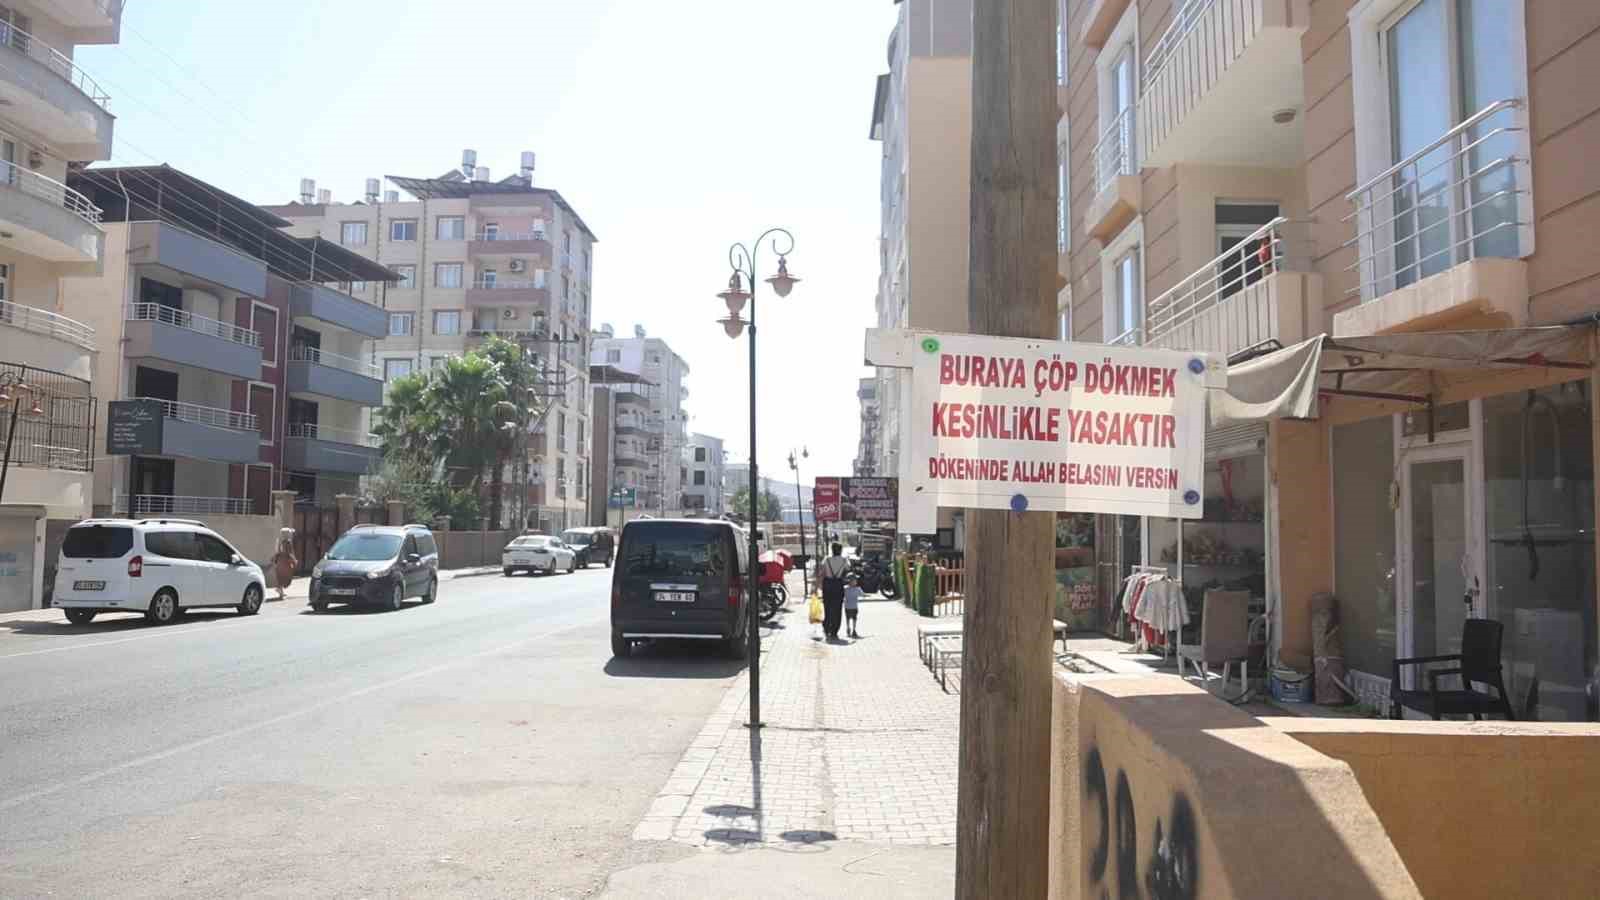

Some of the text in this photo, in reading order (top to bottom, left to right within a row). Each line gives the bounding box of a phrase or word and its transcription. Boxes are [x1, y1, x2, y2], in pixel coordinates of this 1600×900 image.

[940, 353, 1177, 398] BURAYA ÇÖP DÖKMEK
[1067, 409, 1176, 448] YASAKTIR
[1012, 460, 1056, 483] ALLAH
[1059, 462, 1121, 487] BELASINI
